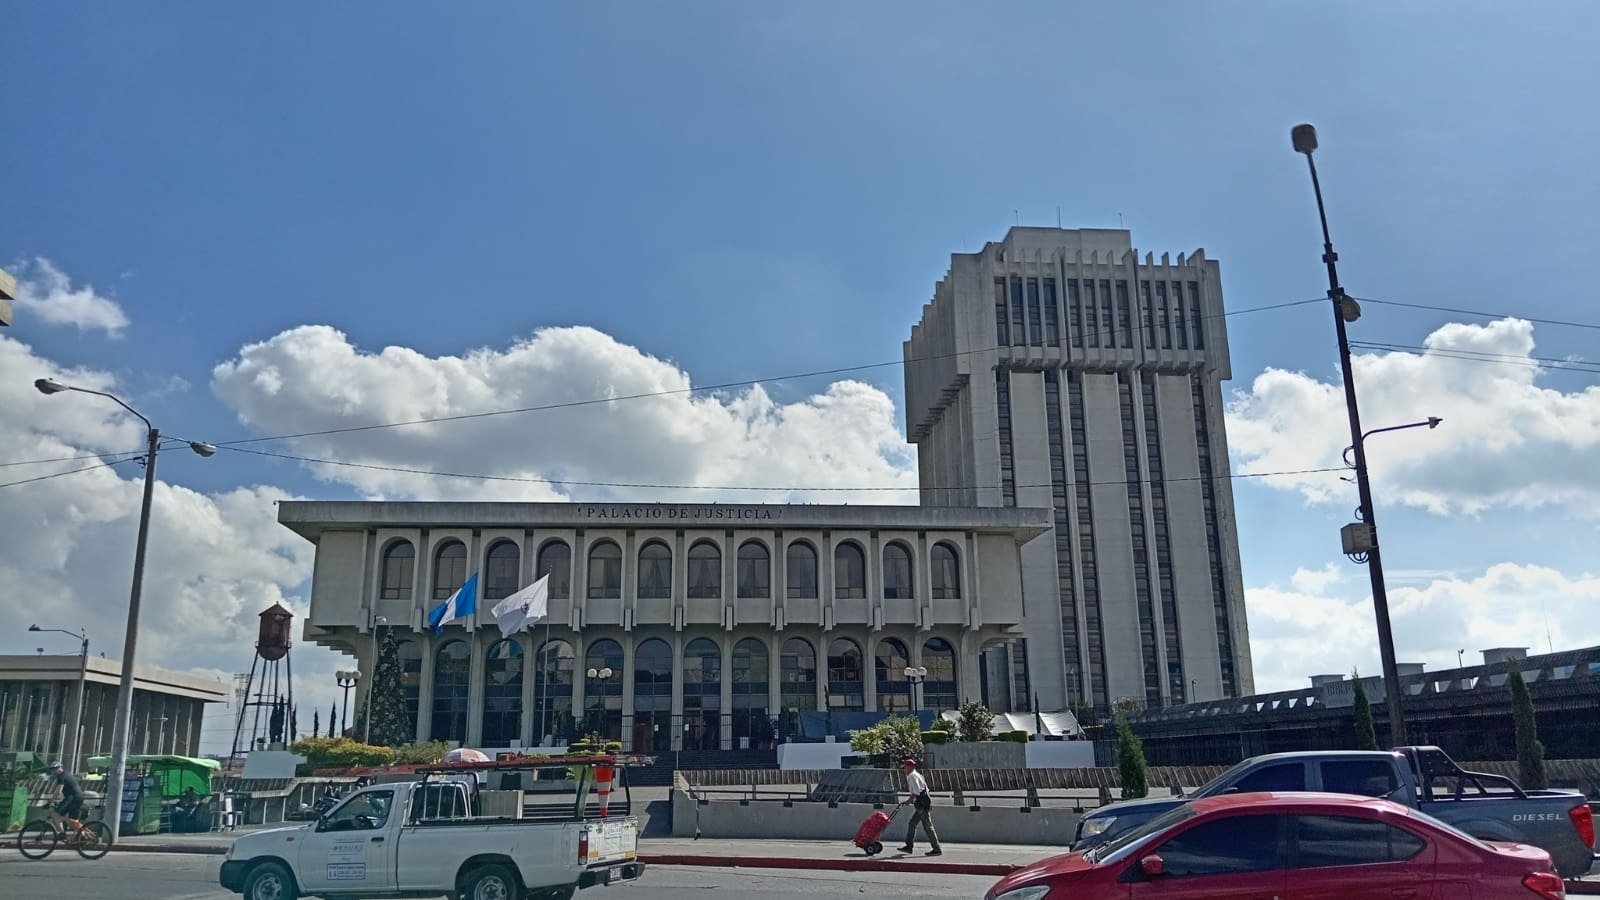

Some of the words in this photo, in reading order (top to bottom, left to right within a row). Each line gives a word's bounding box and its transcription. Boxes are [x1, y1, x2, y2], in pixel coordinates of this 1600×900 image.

[587, 508, 662, 519] PALACIO
[668, 509, 689, 519] DE
[694, 508, 772, 520] JUSTICIA
[1512, 813, 1565, 822] DIESEL
